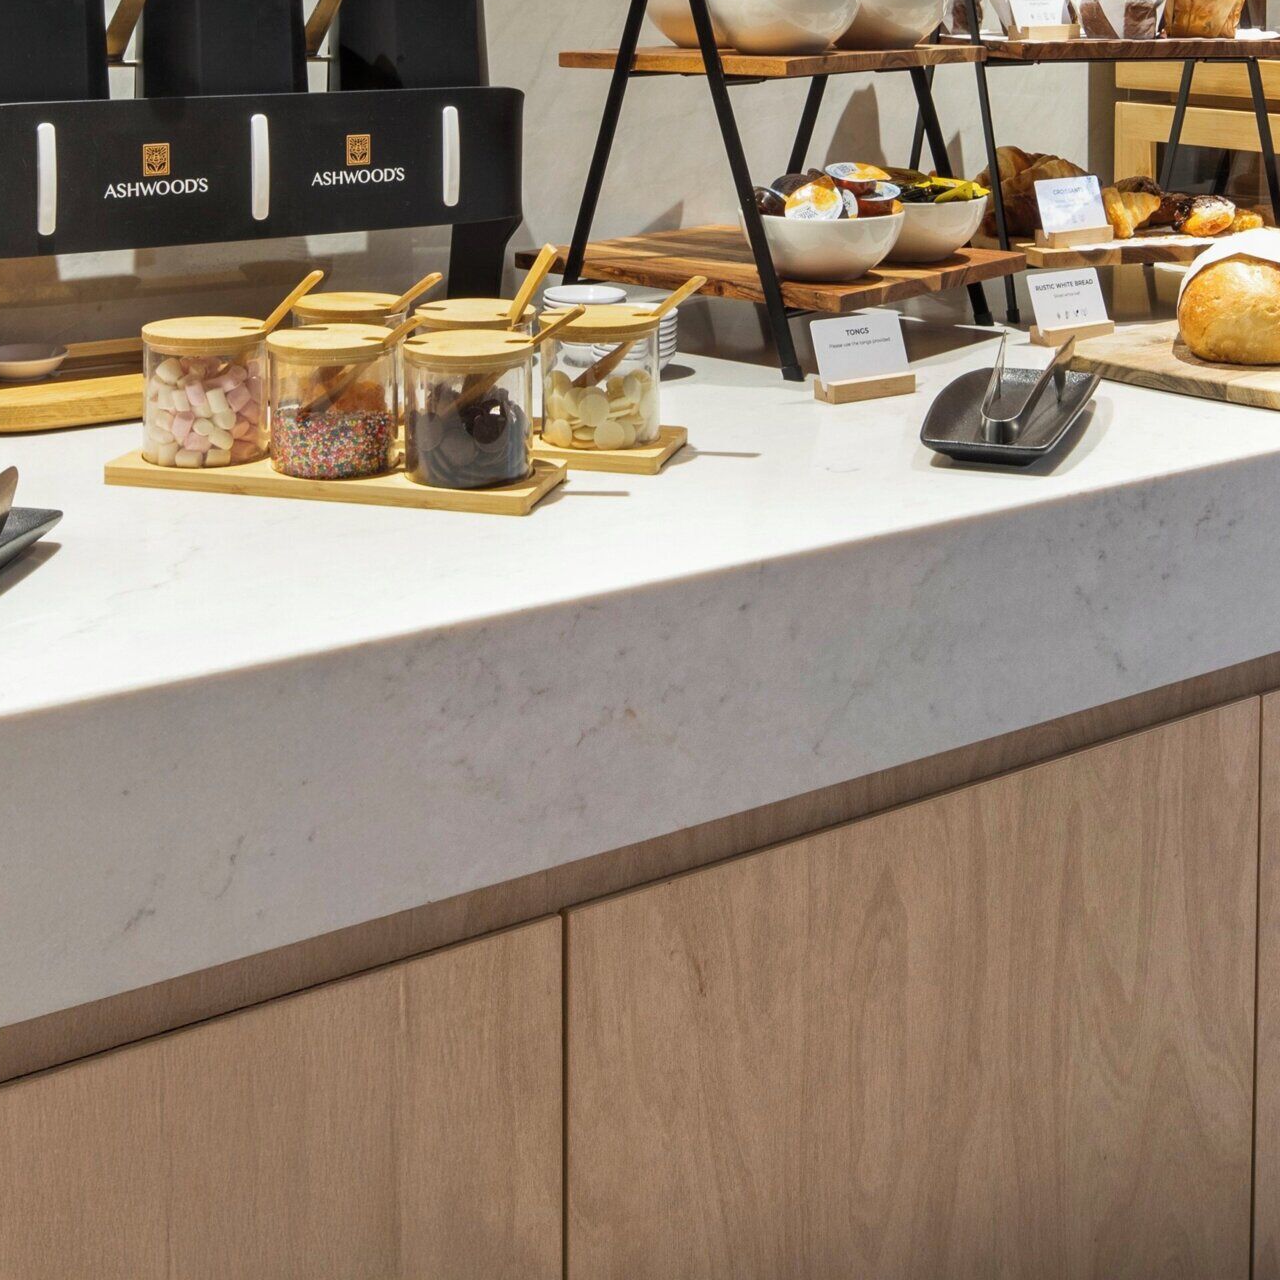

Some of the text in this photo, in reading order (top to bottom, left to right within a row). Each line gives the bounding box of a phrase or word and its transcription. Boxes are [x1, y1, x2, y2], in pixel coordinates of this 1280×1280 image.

[311, 167, 405, 186] ASHWOOD'S
[104, 178, 208, 199] ASHWOOD'S
[1035, 278, 1094, 291] RUSTIC WHITE BREAD
[845, 327, 870, 336] TONGS
